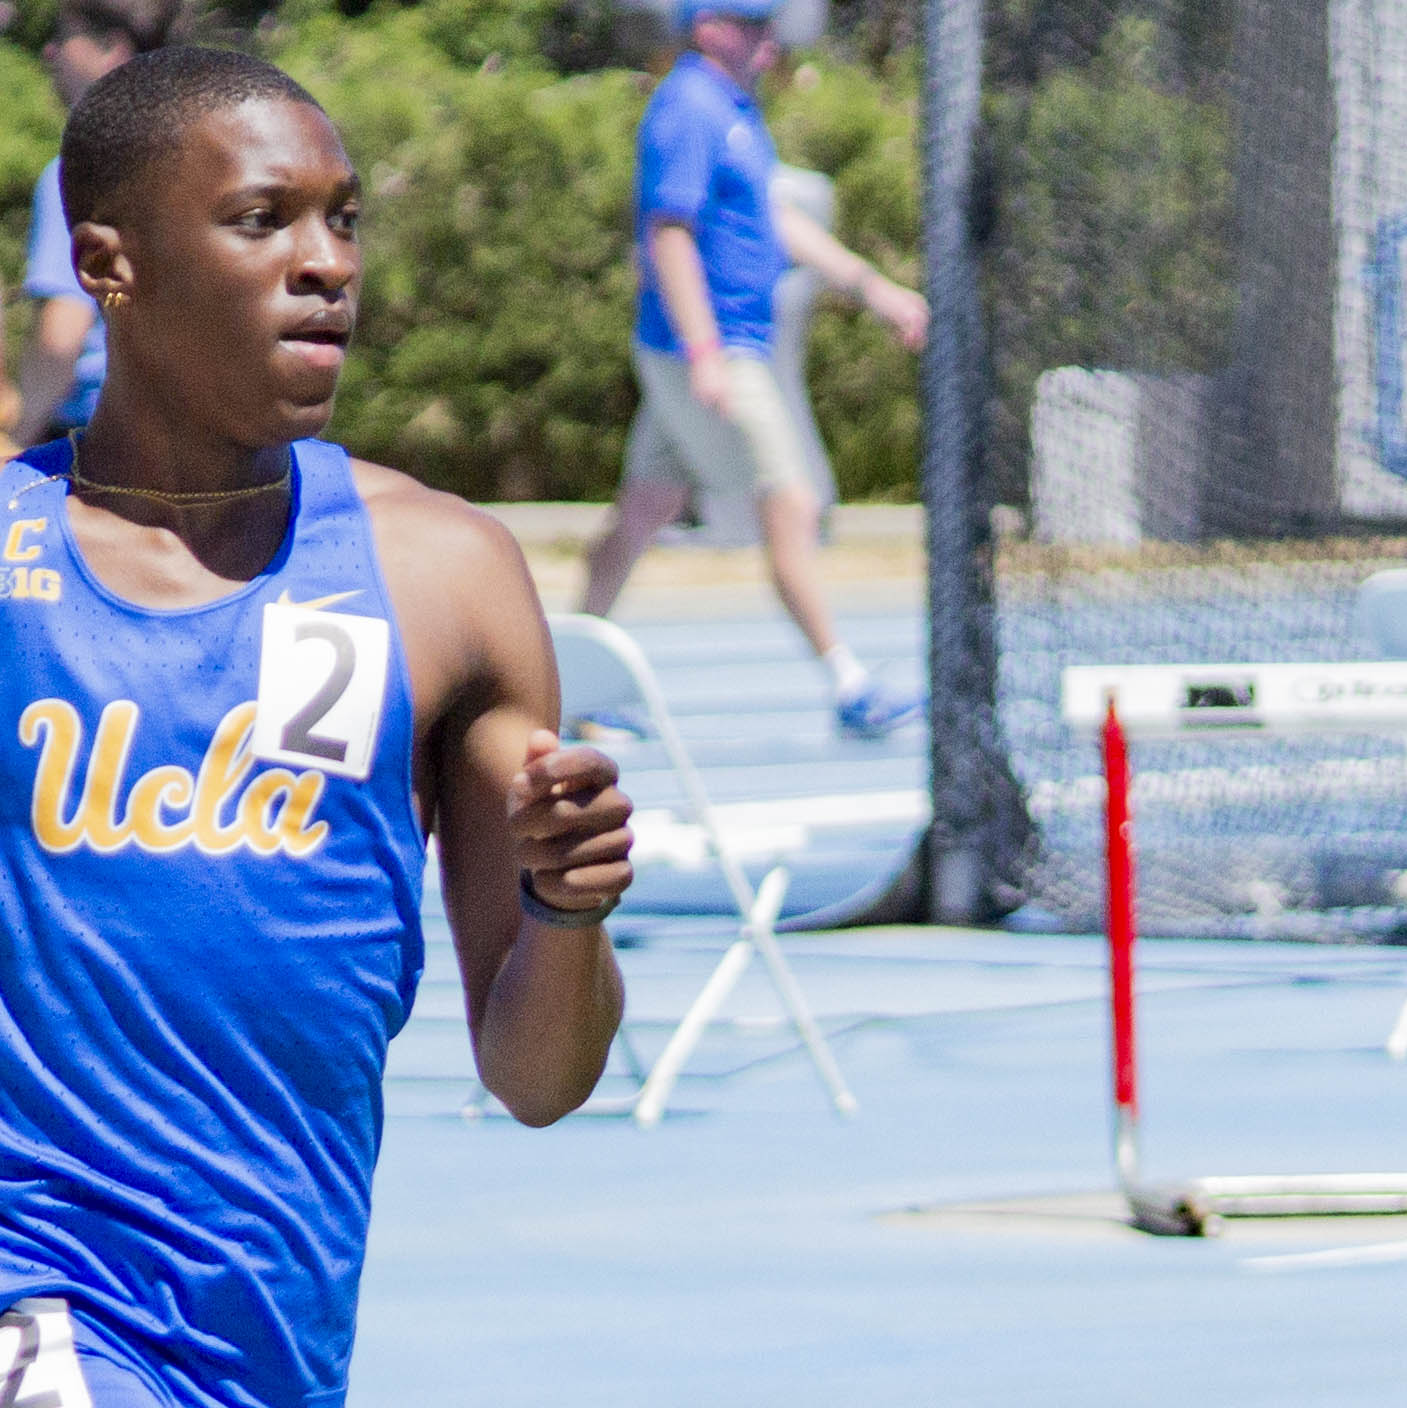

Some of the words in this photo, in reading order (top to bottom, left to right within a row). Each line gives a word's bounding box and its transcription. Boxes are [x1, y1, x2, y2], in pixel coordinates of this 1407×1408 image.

[3, 517, 48, 561] C
[279, 620, 357, 762] 2
[19, 698, 329, 857] Ucla
